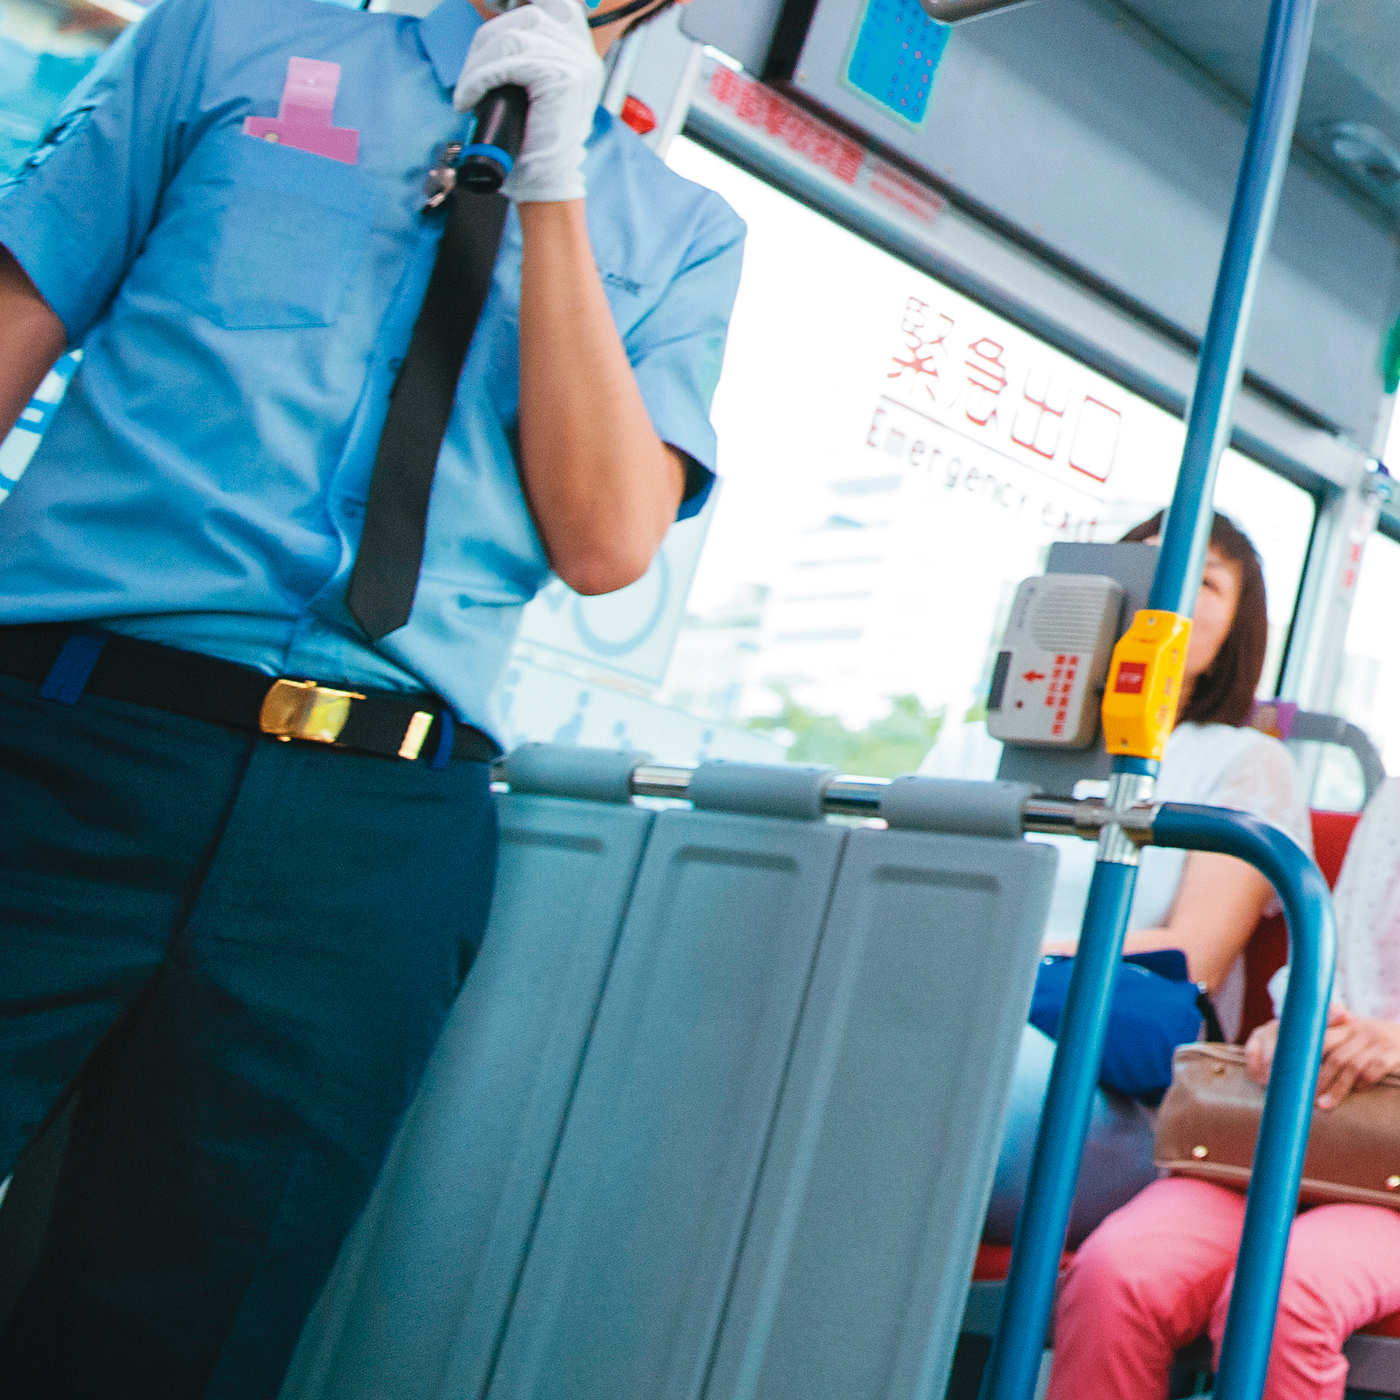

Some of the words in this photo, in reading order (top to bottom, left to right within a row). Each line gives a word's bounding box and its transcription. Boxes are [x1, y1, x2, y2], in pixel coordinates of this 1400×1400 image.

[867, 408, 1027, 512] Emergency
[887, 296, 1122, 484] 緊急出口
